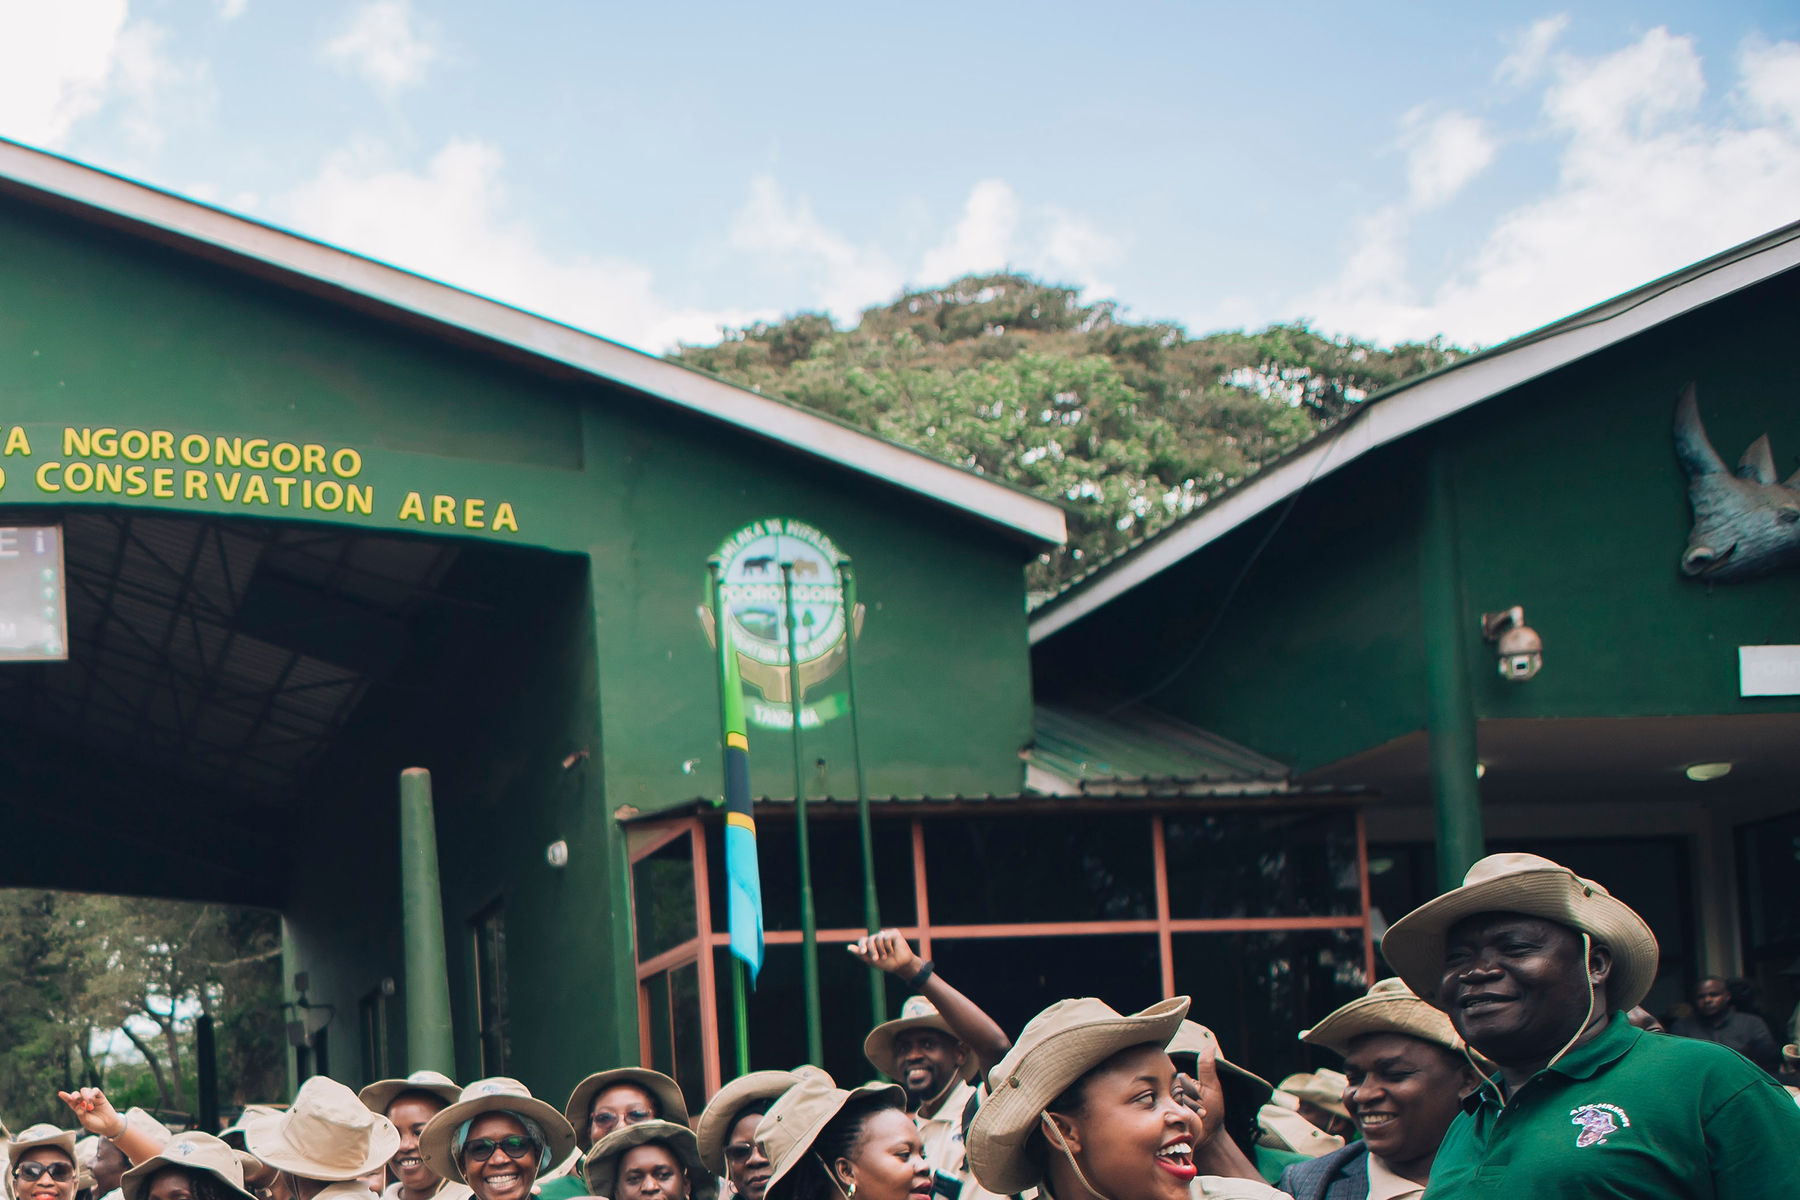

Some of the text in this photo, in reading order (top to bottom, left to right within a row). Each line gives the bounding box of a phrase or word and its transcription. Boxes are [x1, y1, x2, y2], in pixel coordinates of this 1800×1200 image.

[63, 427, 362, 478] NGORONGORO
[36, 462, 373, 514] CONSERVATION
[399, 492, 519, 532] AREA
